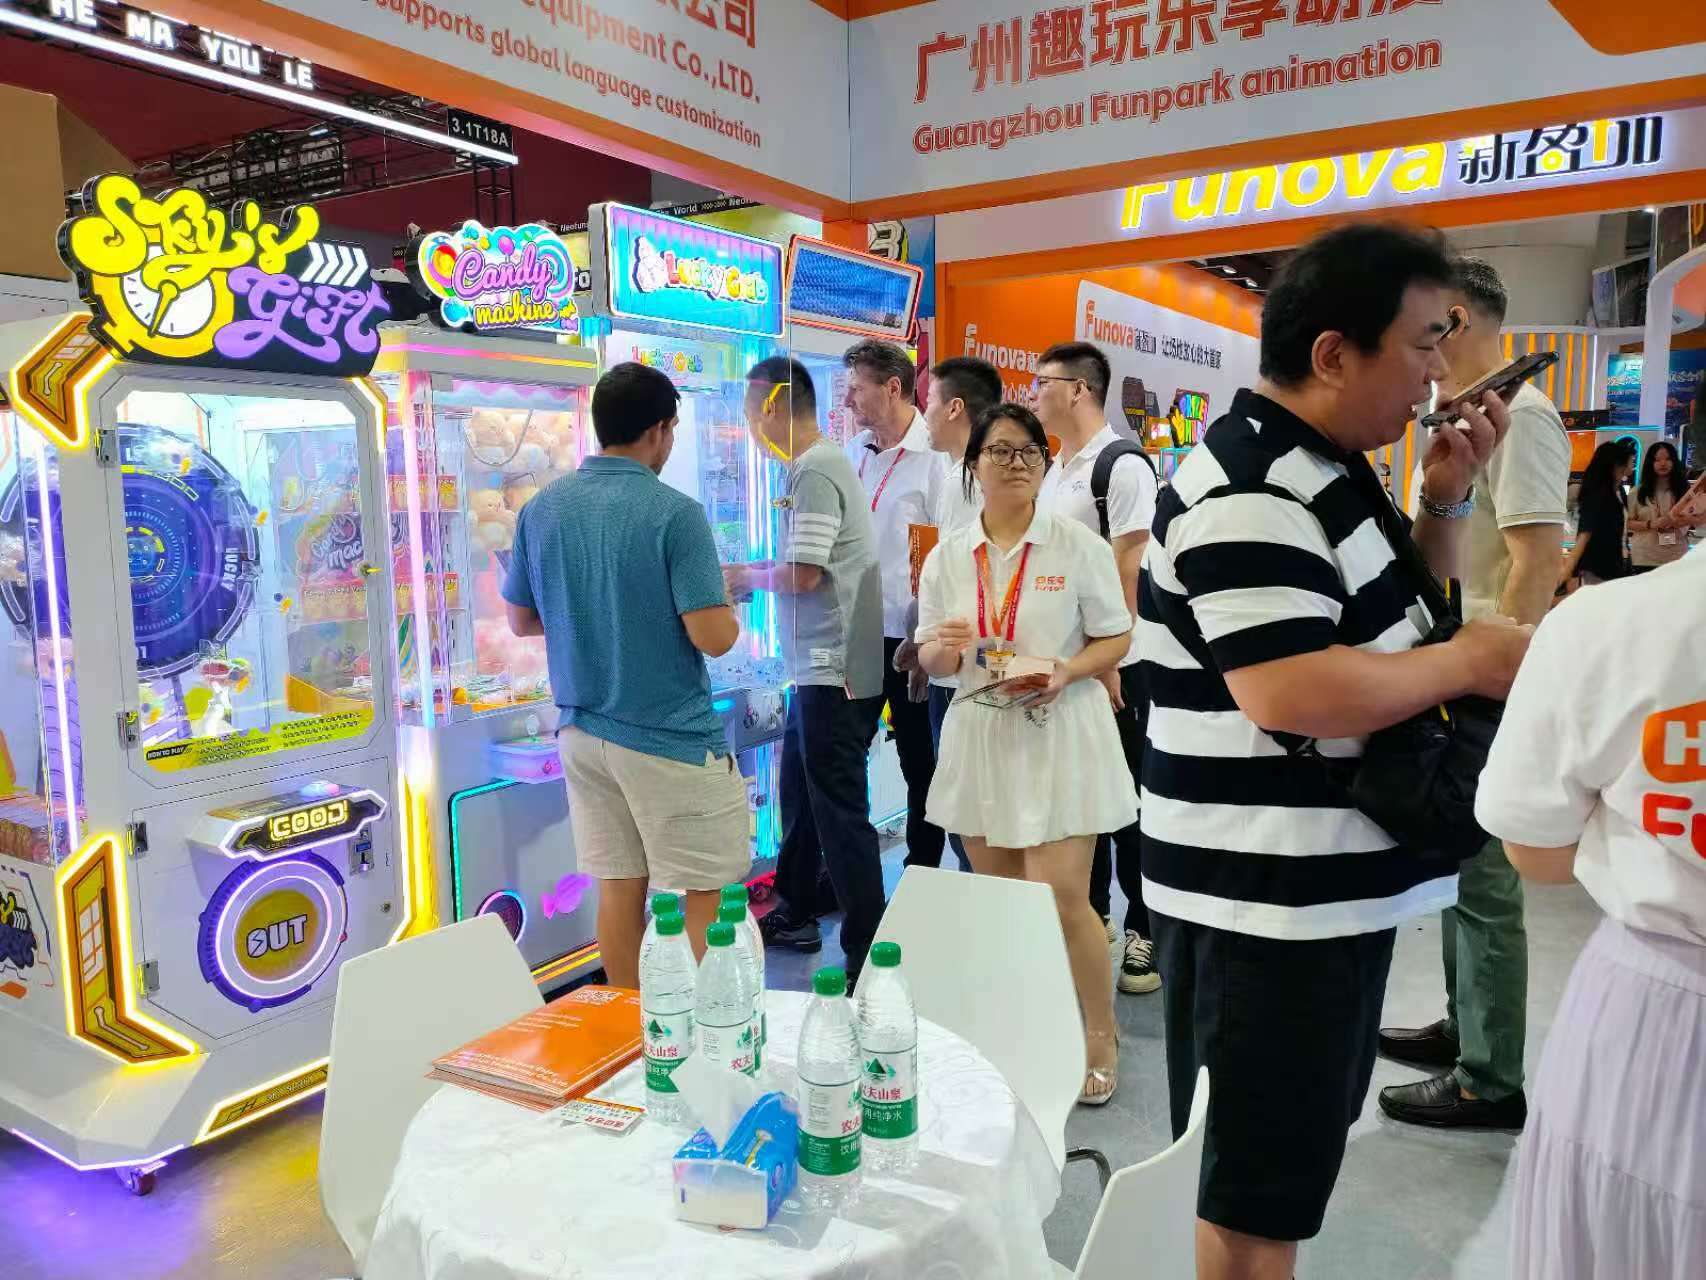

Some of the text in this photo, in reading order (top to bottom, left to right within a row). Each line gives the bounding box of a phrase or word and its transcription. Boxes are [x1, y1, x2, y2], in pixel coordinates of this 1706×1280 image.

[126, 12, 174, 49] MA
[201, 35, 260, 75] YOU
[284, 61, 315, 90] LE
[914, 0, 1444, 103] 广州趣玩乐享
[490, 29, 561, 72] global
[564, 51, 652, 107] language
[654, 94, 761, 149] customization
[913, 38, 1442, 154] Guangzhou Funpark animation
[450, 116, 510, 148] 3.1T18A
[673, 203, 698, 216] World
[452, 241, 553, 302] Candy
[213, 265, 392, 363] Gift
[474, 288, 557, 328] machine
[1084, 299, 1134, 348] Funova
[273, 803, 345, 838] GOOD
[247, 914, 307, 958] OUT
[643, 1043, 679, 1058] 夫山泉
